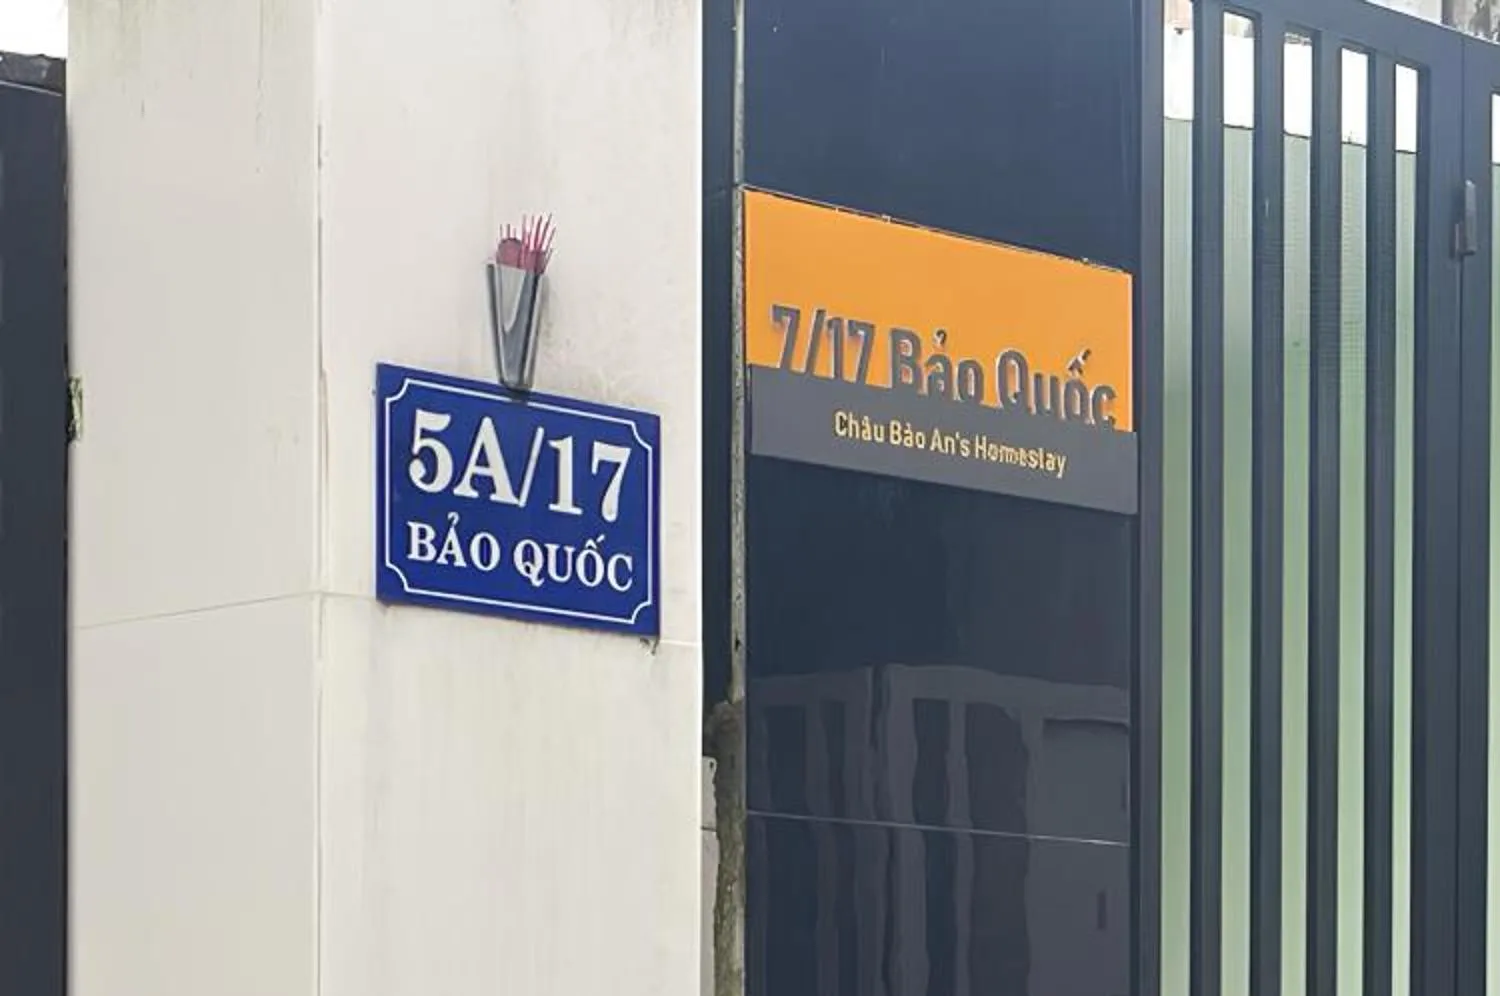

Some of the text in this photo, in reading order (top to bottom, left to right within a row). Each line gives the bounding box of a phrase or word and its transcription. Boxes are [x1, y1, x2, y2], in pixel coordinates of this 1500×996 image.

[771, 303, 1118, 430] 7/17 Bảo Quốc
[408, 408, 632, 523] 5A/17
[834, 410, 885, 443] Châu
[889, 419, 927, 449] Bảo
[929, 427, 971, 457] An's
[407, 512, 634, 592] BẢO QUỐC
